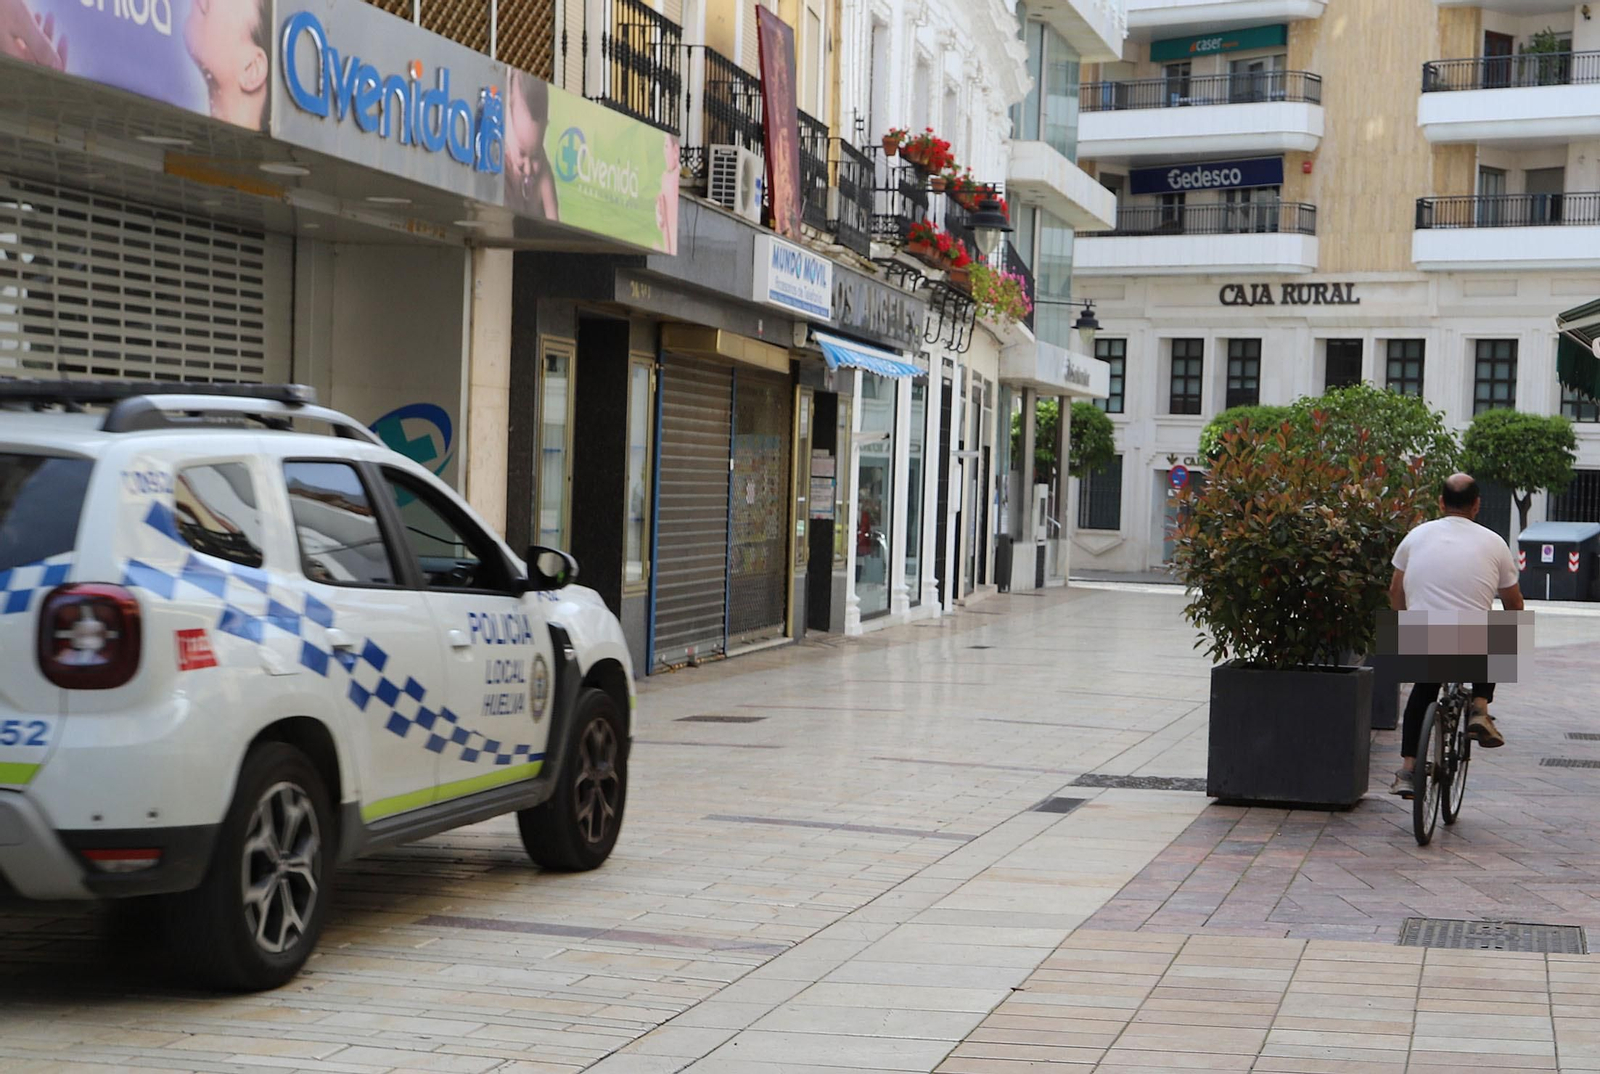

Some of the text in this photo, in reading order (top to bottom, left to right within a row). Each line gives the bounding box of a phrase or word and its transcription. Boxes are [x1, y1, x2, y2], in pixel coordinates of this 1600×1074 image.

[1195, 37, 1222, 52] caser
[1167, 166, 1242, 189] Gedesco
[772, 243, 803, 280] MUNDO
[1219, 282, 1360, 307] CAJA RURAL
[485, 660, 526, 684] LOCAL
[482, 693, 527, 716] HUELVA
[0, 719, 47, 747] 52
